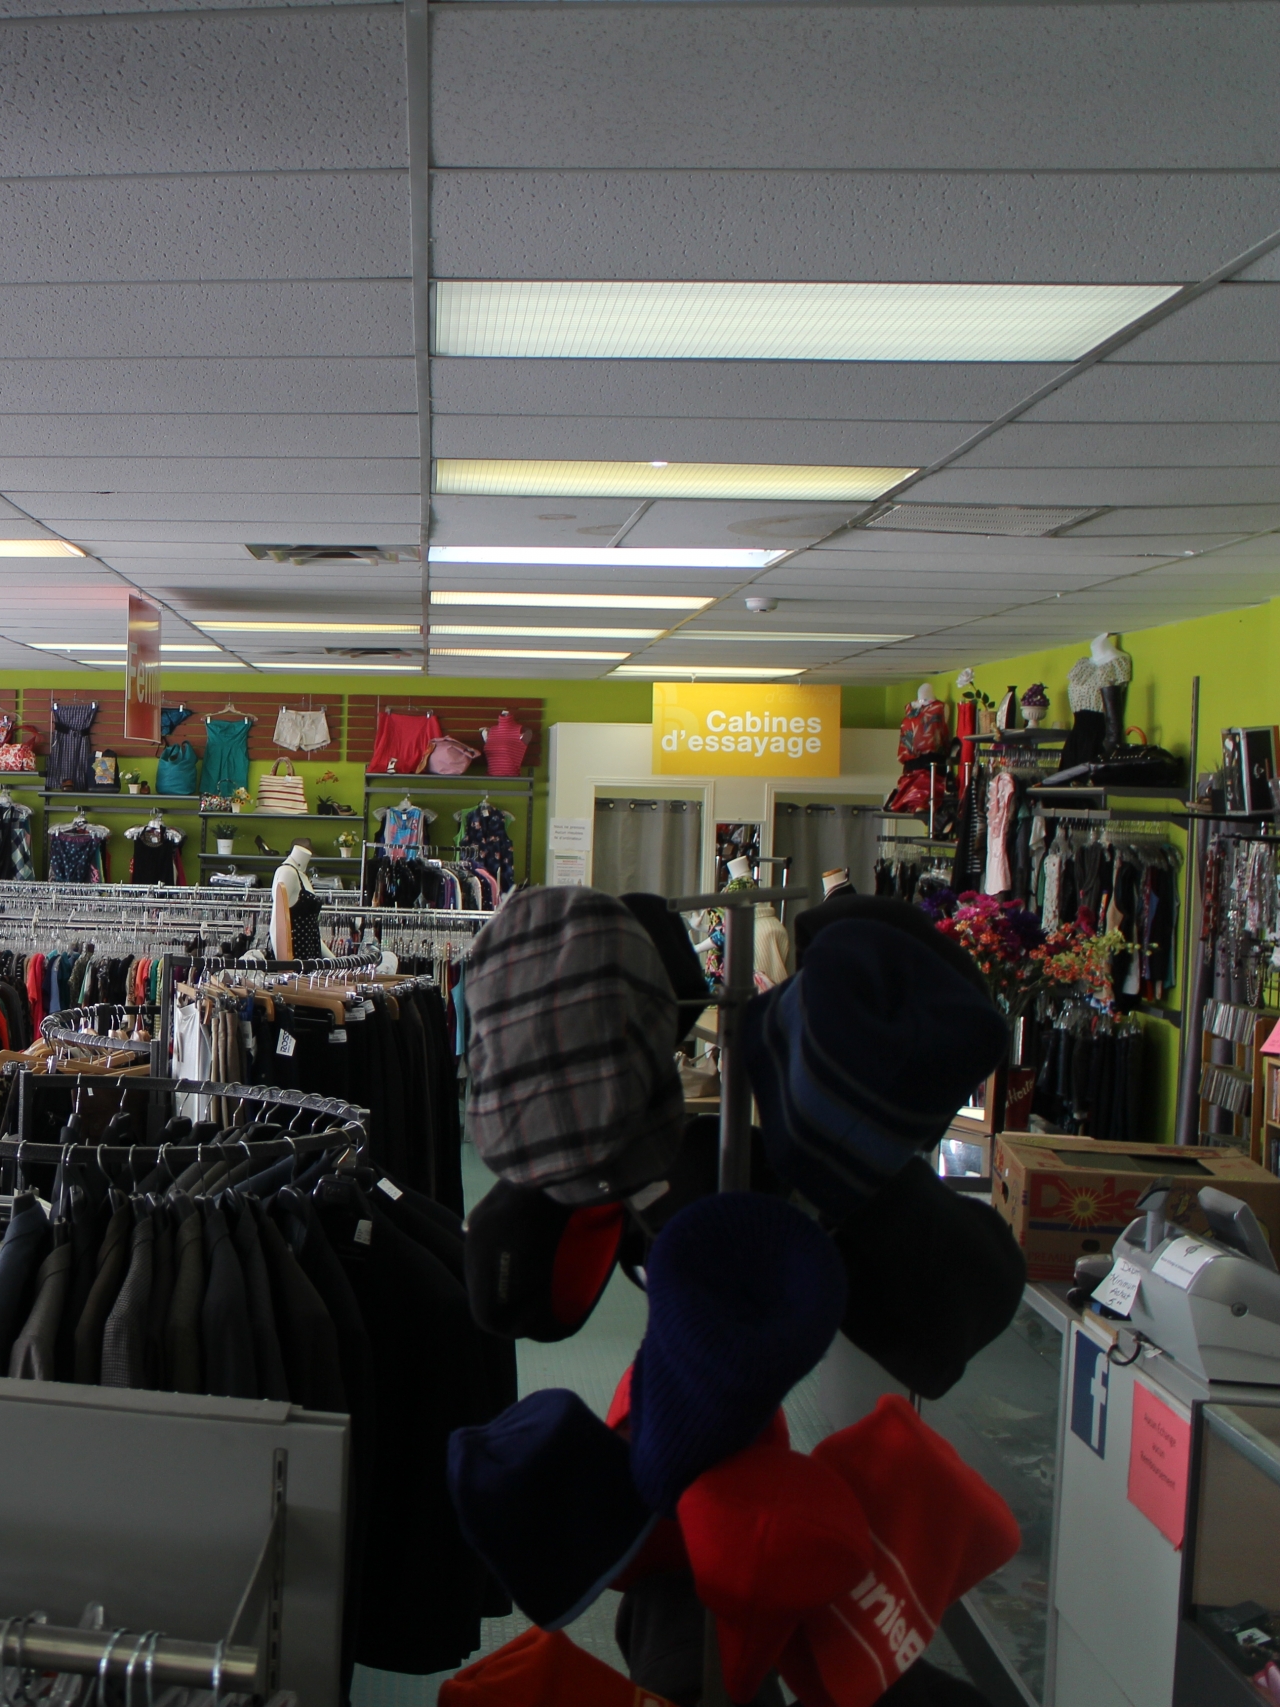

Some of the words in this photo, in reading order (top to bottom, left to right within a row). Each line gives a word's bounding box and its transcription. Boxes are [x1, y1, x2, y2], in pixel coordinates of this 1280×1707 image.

[706, 710, 822, 733] Cabines
[661, 729, 822, 758] d'essayage
[1028, 1252, 1077, 1262] PREMIU
[1090, 1352, 1108, 1450] f
